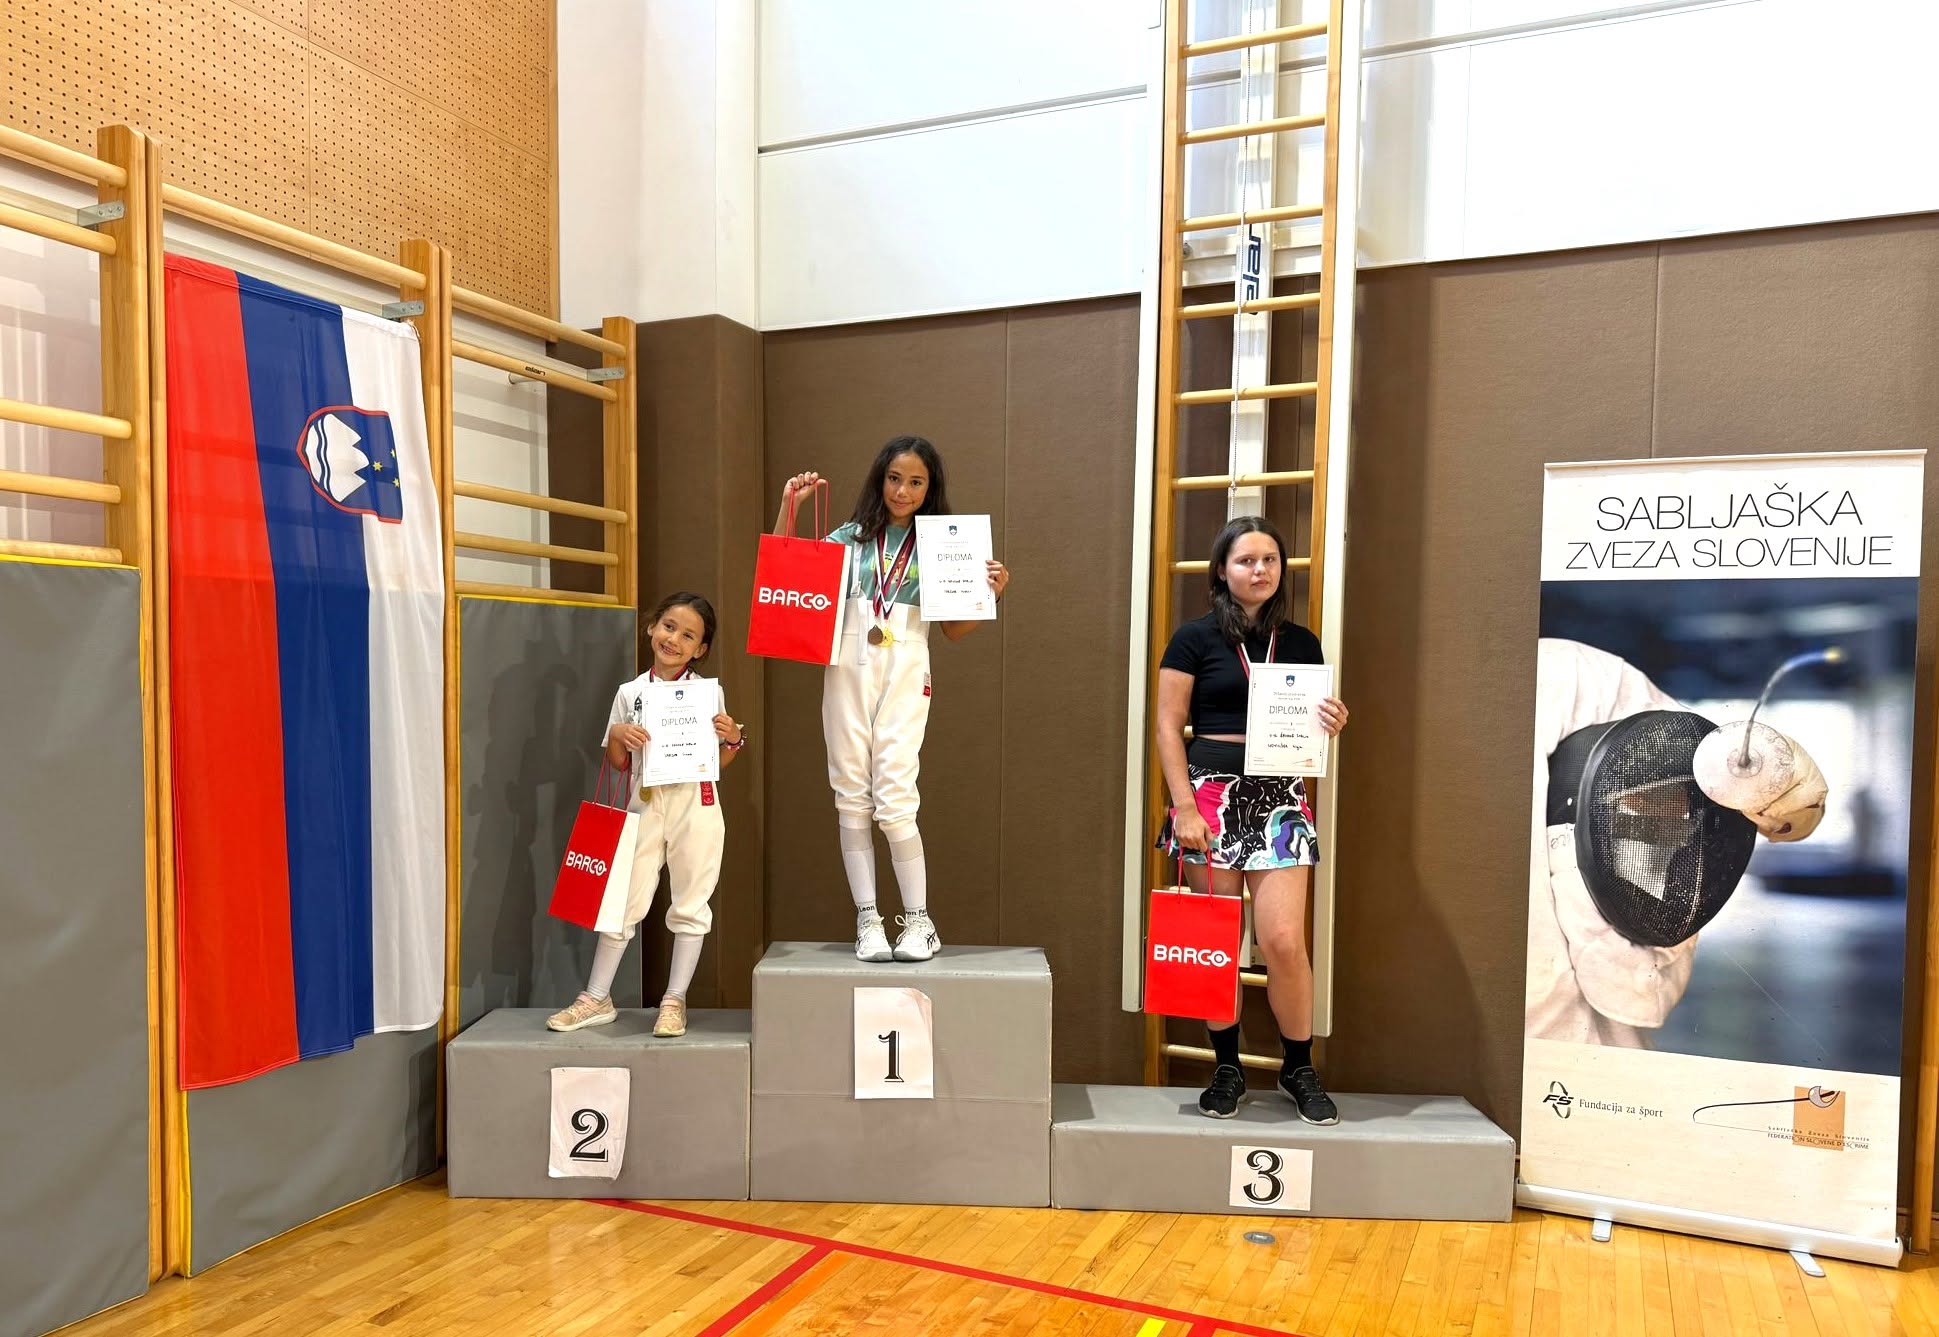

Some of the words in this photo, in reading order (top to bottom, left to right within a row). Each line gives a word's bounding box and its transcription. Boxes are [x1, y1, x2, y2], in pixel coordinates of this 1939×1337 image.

[1596, 482, 1863, 532] SABLJAŠKA
[937, 553, 973, 562] DIPLOMA
[1566, 540, 1681, 569] ZVEZA
[1692, 535, 1894, 568] SLOVENIJE
[758, 586, 832, 611] BARCO
[661, 716, 698, 727] DIPLOMA
[1269, 705, 1308, 715] DIPLOMA
[565, 850, 607, 877] BARCO
[859, 905, 875, 913] Leon
[1153, 943, 1232, 968] BARCO
[877, 1030, 905, 1083] 1
[1542, 1094, 1575, 1106] FS
[1579, 1098, 1623, 1115] Fundacija
[1626, 1104, 1636, 1114] za
[1638, 1105, 1664, 1118] šport
[569, 1107, 609, 1163] 2
[1243, 1149, 1285, 1206] 3
